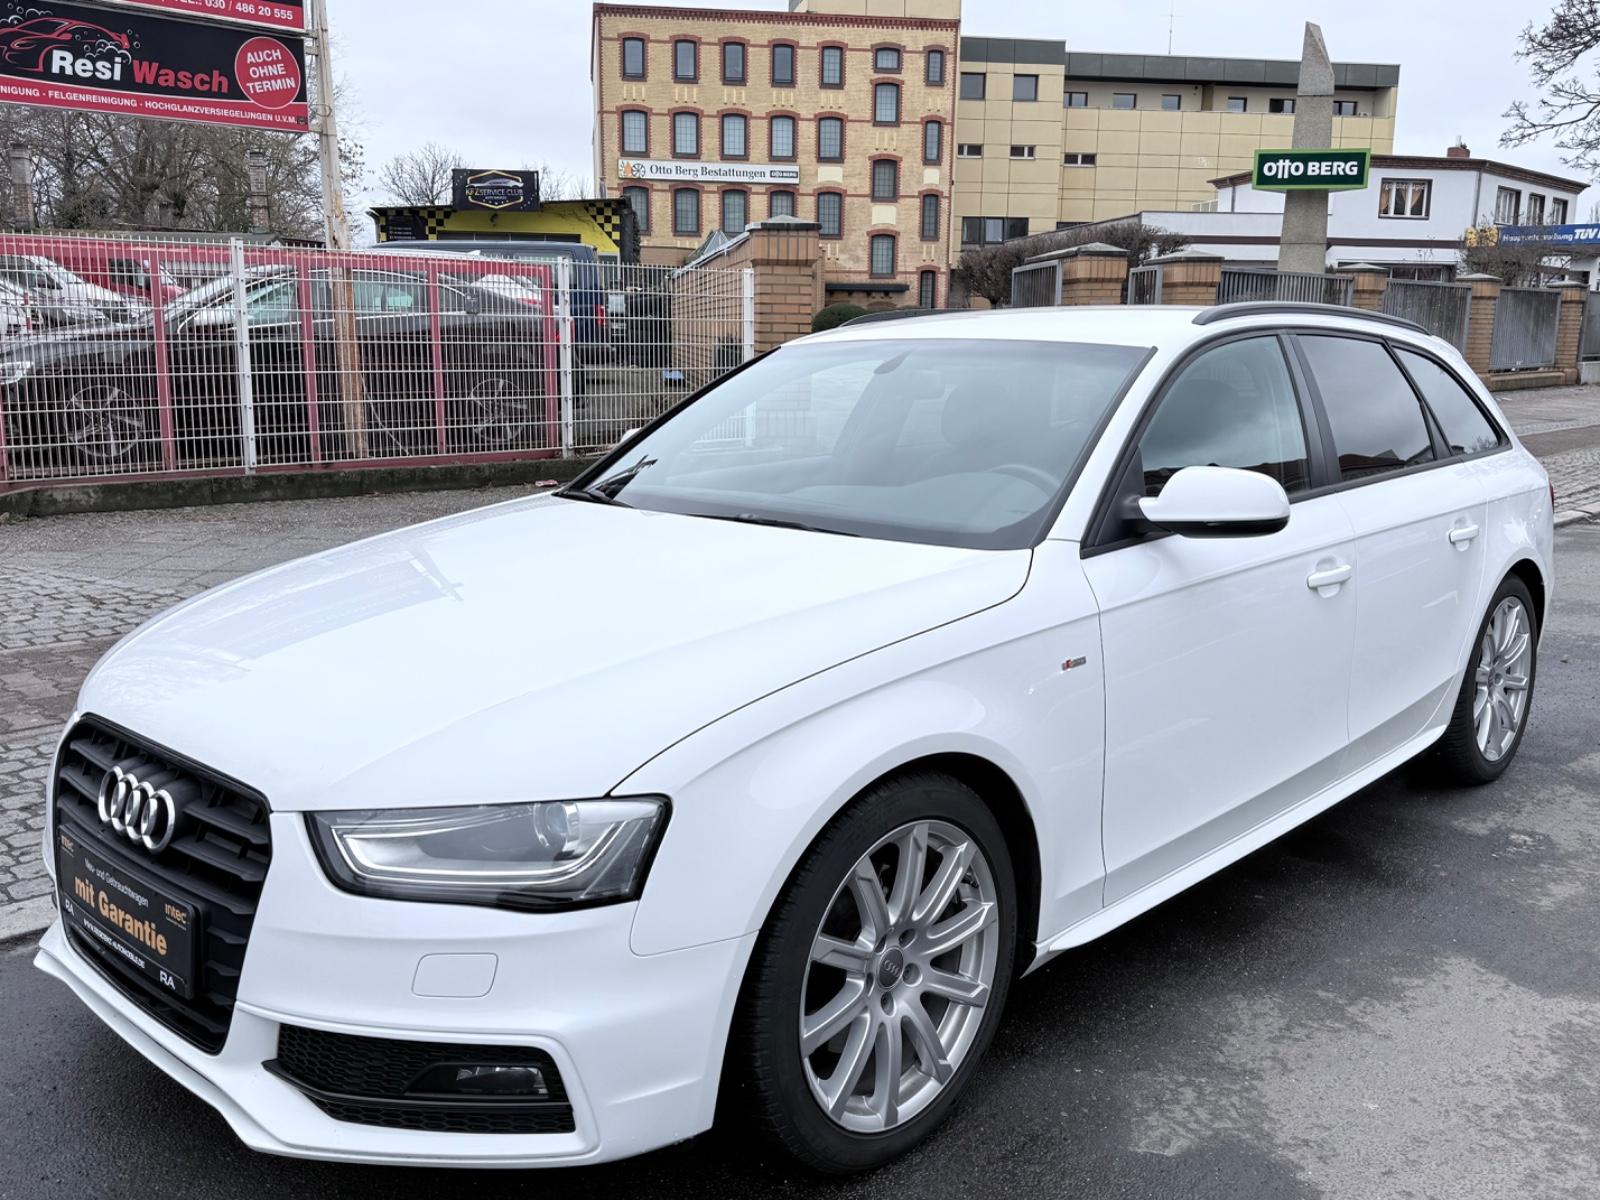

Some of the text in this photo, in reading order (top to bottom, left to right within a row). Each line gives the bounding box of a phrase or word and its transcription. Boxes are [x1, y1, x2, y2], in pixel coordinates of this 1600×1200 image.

[235, 2, 255, 14] 486
[258, 5, 272, 17] 20
[274, 8, 293, 20] 555
[246, 49, 282, 64] AUCH
[51, 49, 229, 94] Resi Wasch
[249, 63, 287, 79] OHNE
[246, 77, 296, 94] TERMIN
[48, 90, 138, 107] FELGENREINIGUNG
[144, 100, 273, 121] HOCHGLANZVERSIEGELUNGEN
[650, 164, 673, 176] Otto
[675, 165, 699, 178] Berg
[700, 166, 766, 180] Bestattungen
[1307, 161, 1358, 176] BERG
[74, 876, 168, 956] mit Garantie
[160, 970, 176, 991] RA
